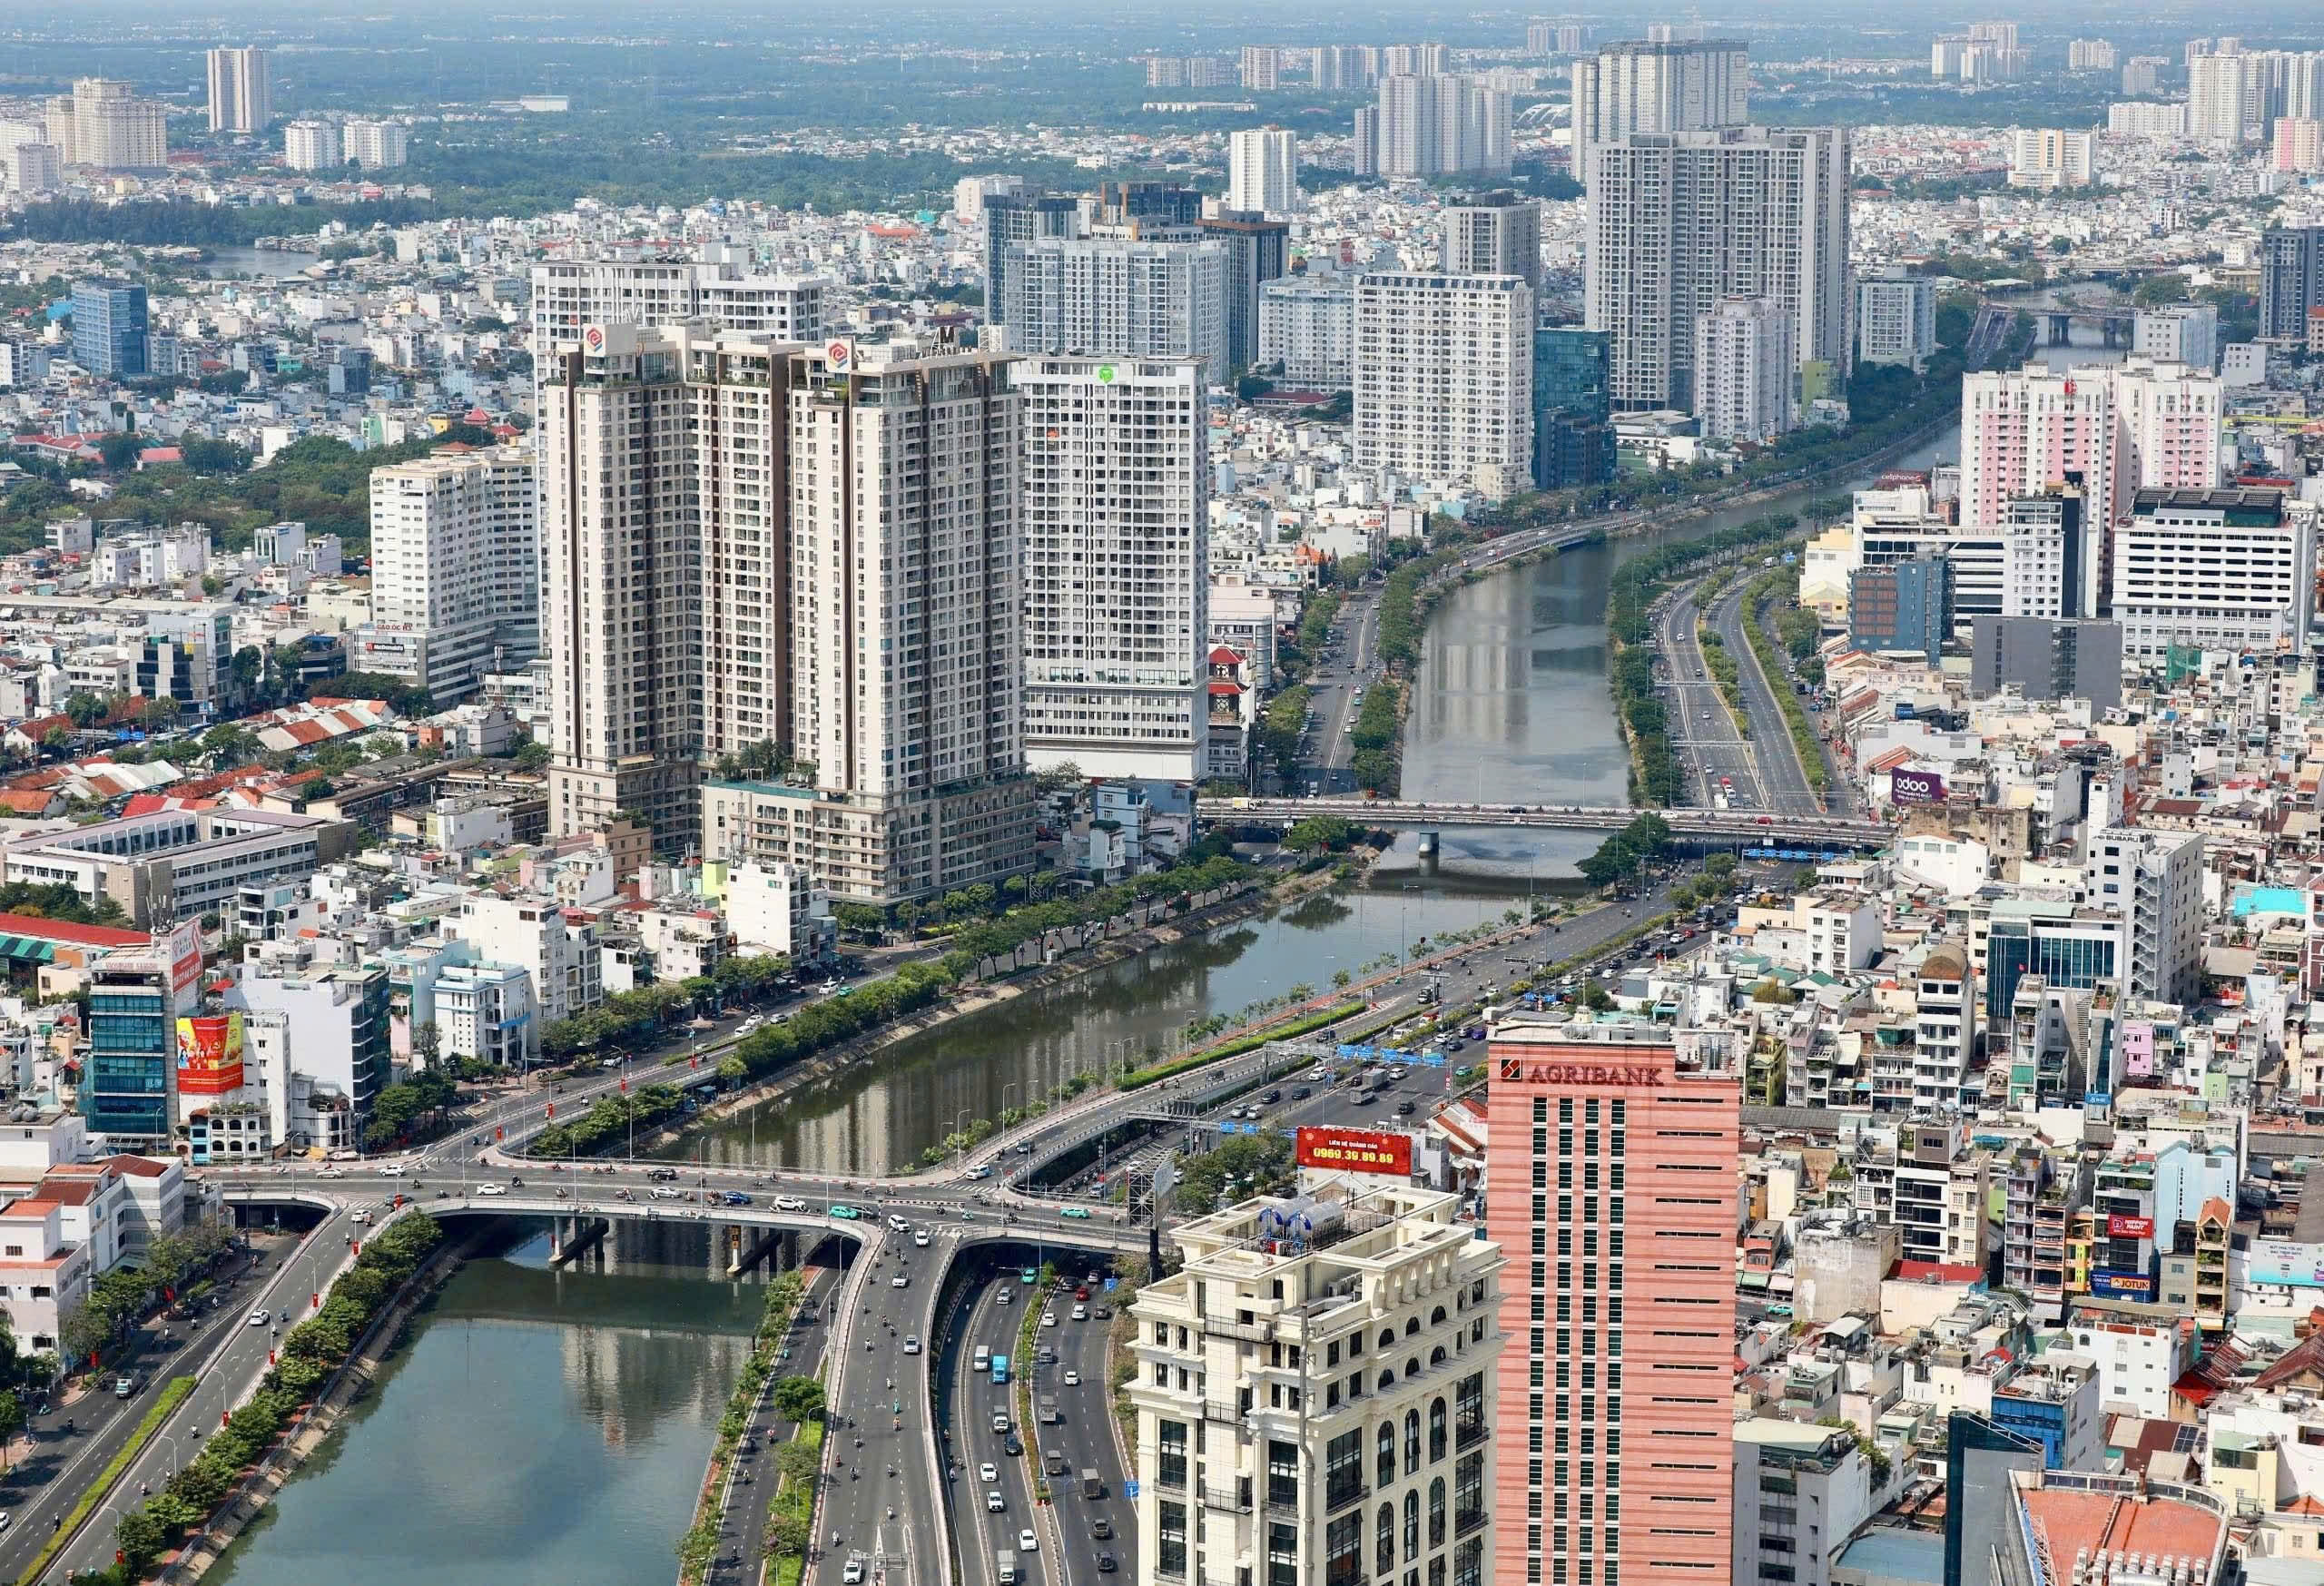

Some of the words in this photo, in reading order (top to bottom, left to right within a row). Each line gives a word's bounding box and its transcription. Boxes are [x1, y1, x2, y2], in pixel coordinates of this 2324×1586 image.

[1896, 777, 1929, 793] odoo
[2106, 834, 2139, 842] SUBARU
[1529, 1064, 1664, 1086] AGRIBANK
[2121, 1280, 2149, 1289] JOTUN
